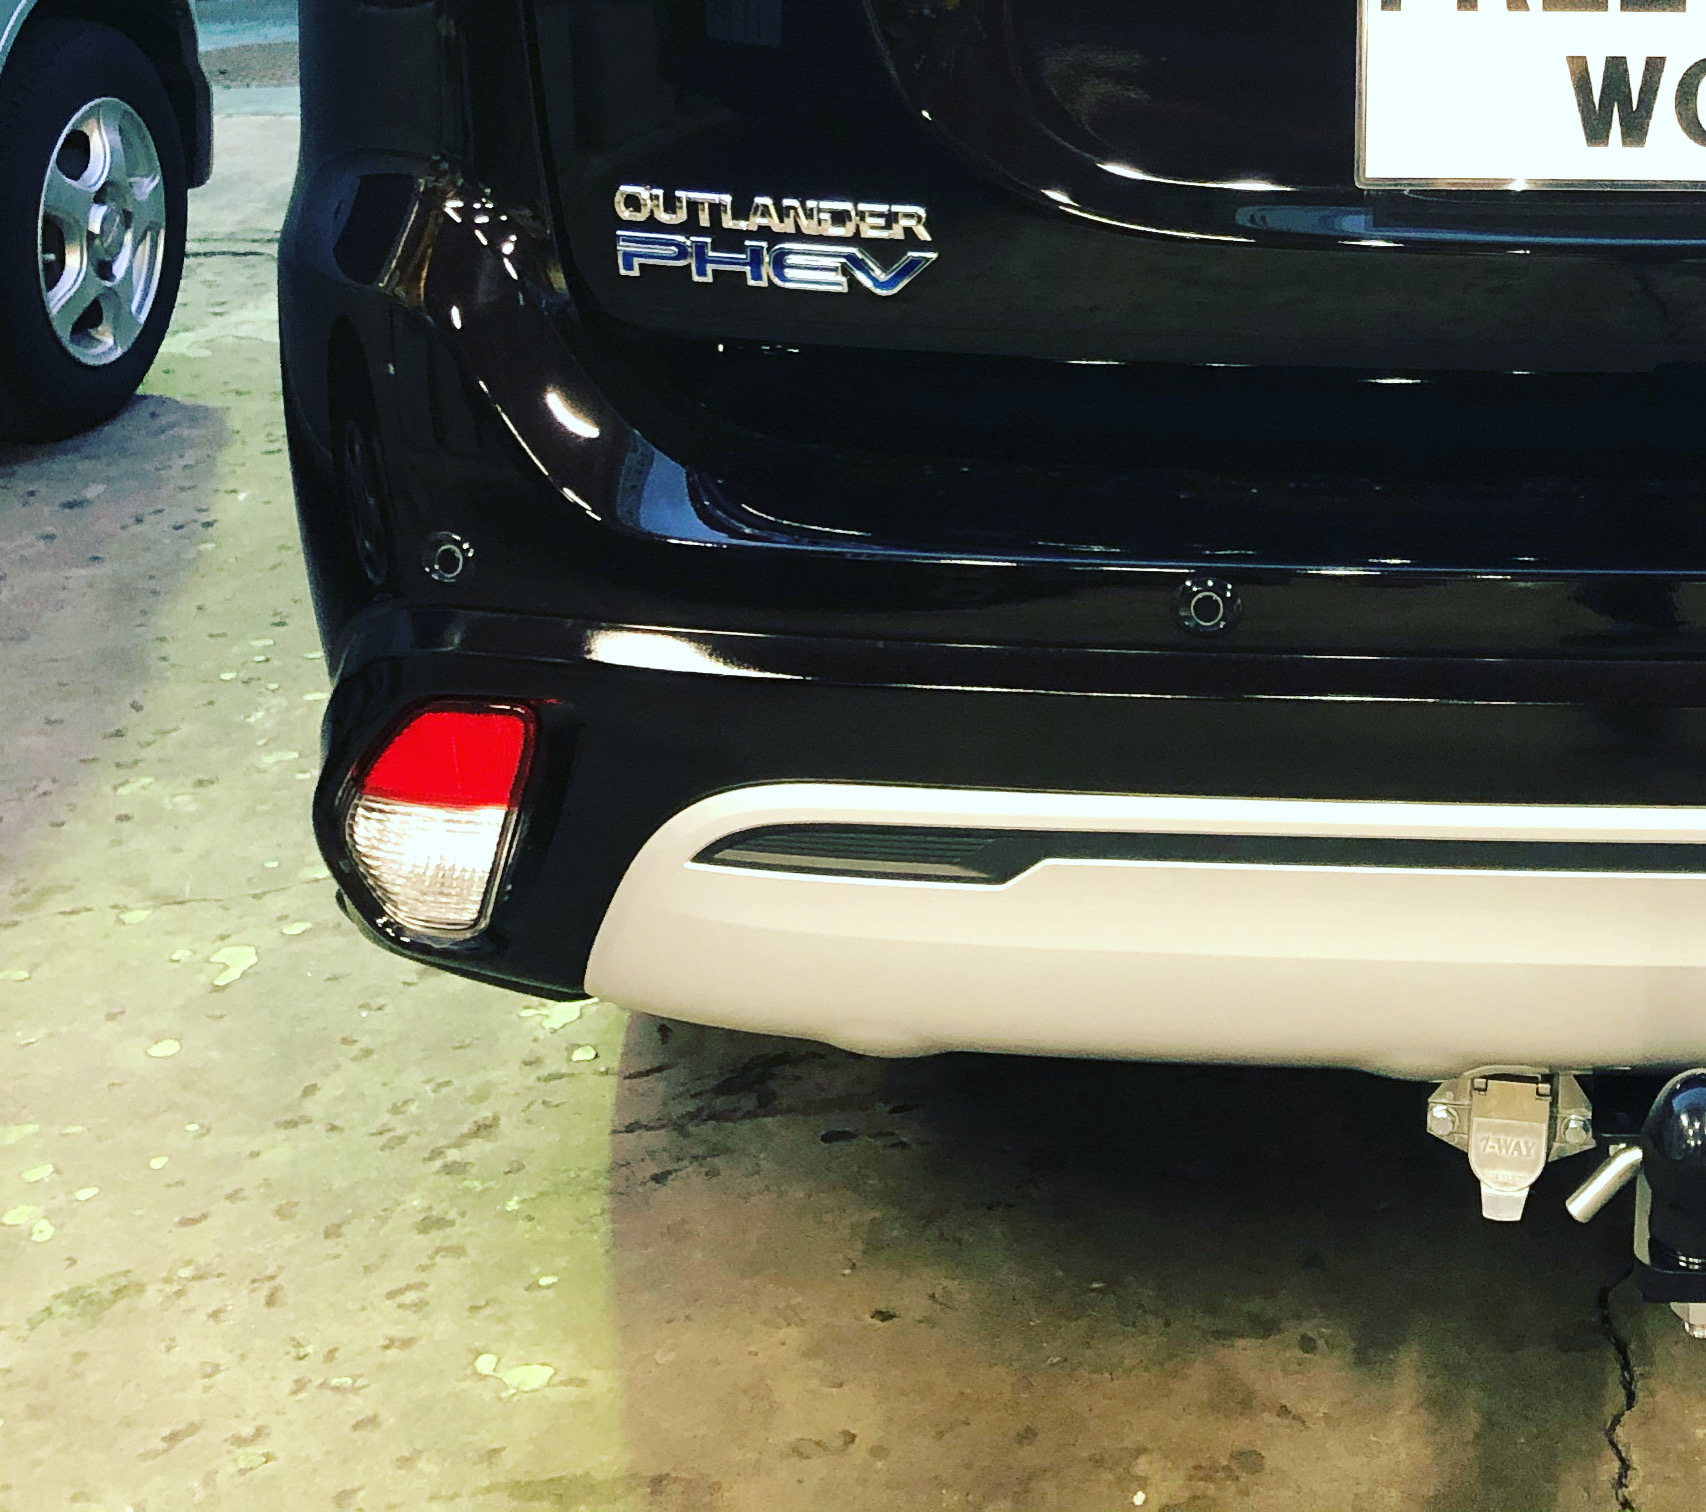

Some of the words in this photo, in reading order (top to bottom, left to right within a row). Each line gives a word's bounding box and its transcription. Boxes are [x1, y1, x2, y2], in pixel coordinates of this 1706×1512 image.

[613, 184, 933, 242] OUTLANDER
[615, 230, 939, 296] PHEV
[1480, 1133, 1537, 1156] 7-WAY
